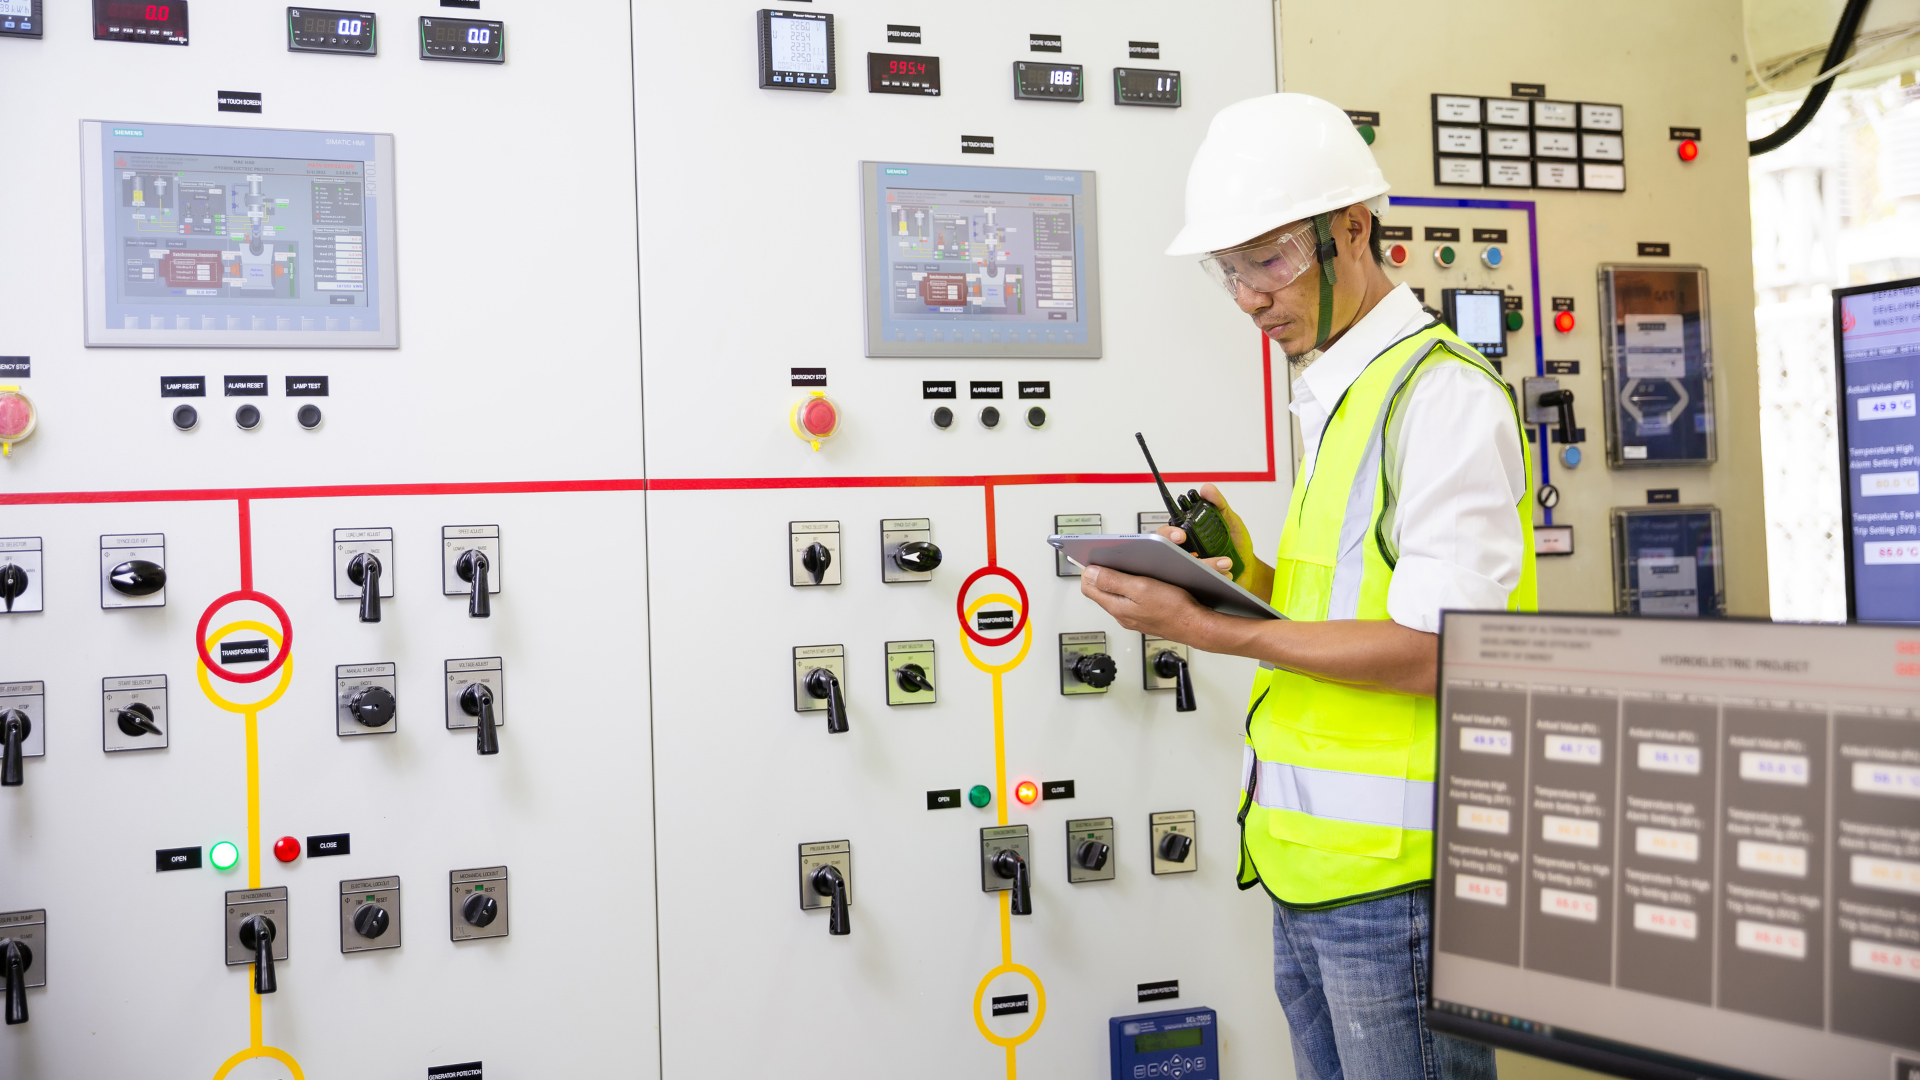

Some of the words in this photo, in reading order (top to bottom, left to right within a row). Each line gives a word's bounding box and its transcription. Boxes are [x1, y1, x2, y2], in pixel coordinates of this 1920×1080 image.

[890, 60, 925, 75] 995.4
[1847, 384, 1870, 395] Actual
[1871, 382, 1892, 392] Value
[1849, 446, 1894, 458] Temperature
[1895, 444, 1914, 456] High
[1849, 460, 1872, 470] Alarm
[1872, 458, 1899, 468] Setting
[1853, 512, 1898, 523] Temperature
[1869, 526, 1896, 536] Setting
[222, 648, 258, 656] TRANSFORMER
[1660, 655, 1752, 669] HYDROELECTRIC
[1755, 659, 1810, 673] PROJECT
[1051, 786, 1065, 794] CLOSE
[351, 882, 372, 890] ELECTRICAL
[372, 880, 390, 888] LOCKOUT
[1138, 988, 1158, 996] GENERATOR
[992, 1002, 1015, 1010] GENERATOR
[429, 1072, 456, 1080] GENERATOR
[456, 1069, 482, 1078] POTECTION
